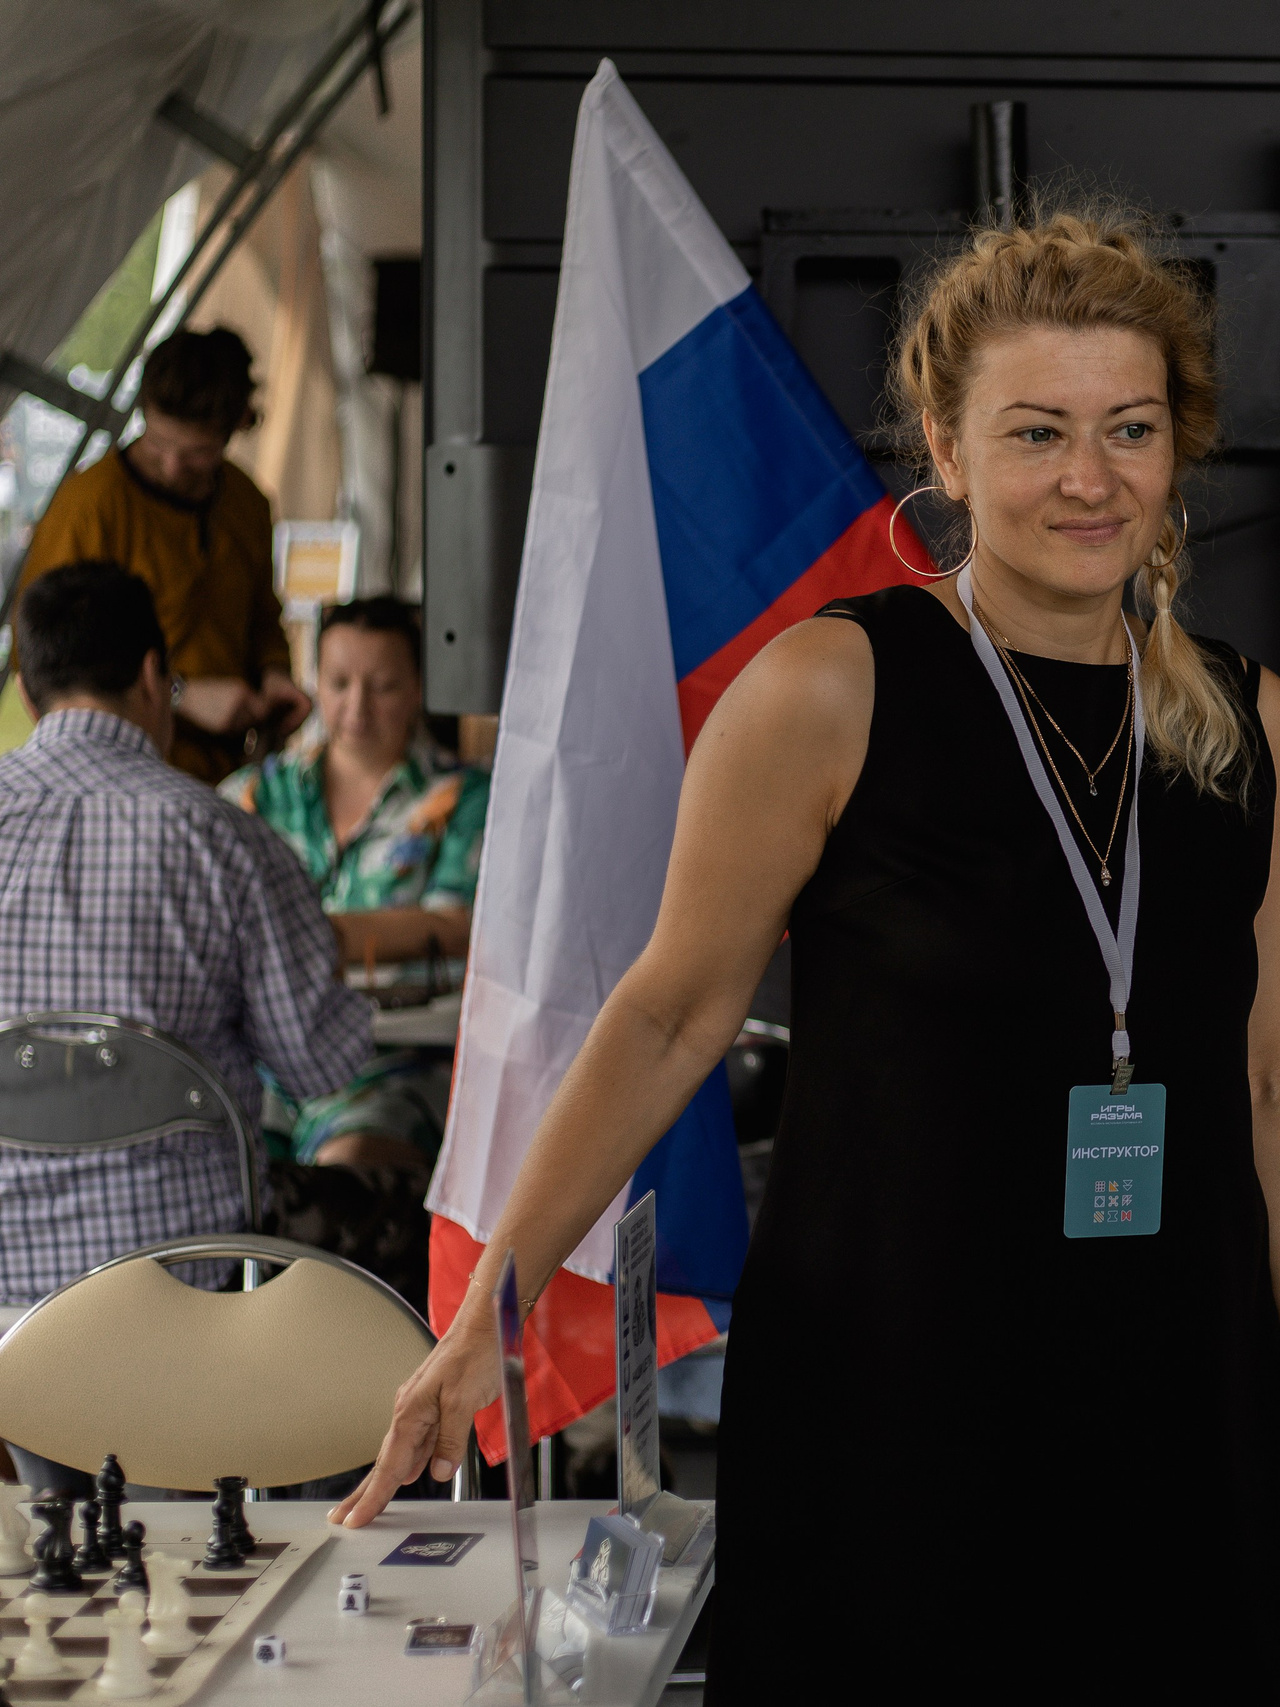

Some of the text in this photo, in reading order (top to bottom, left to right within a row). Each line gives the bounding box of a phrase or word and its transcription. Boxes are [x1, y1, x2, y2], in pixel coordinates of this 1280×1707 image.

[1100, 1104, 1135, 1113] ИГРЫ
[1090, 1112, 1143, 1121] РАЗУМА
[1072, 1145, 1159, 1159] ИНСТРУКТОР
[621, 1234, 632, 1393] CHESS
